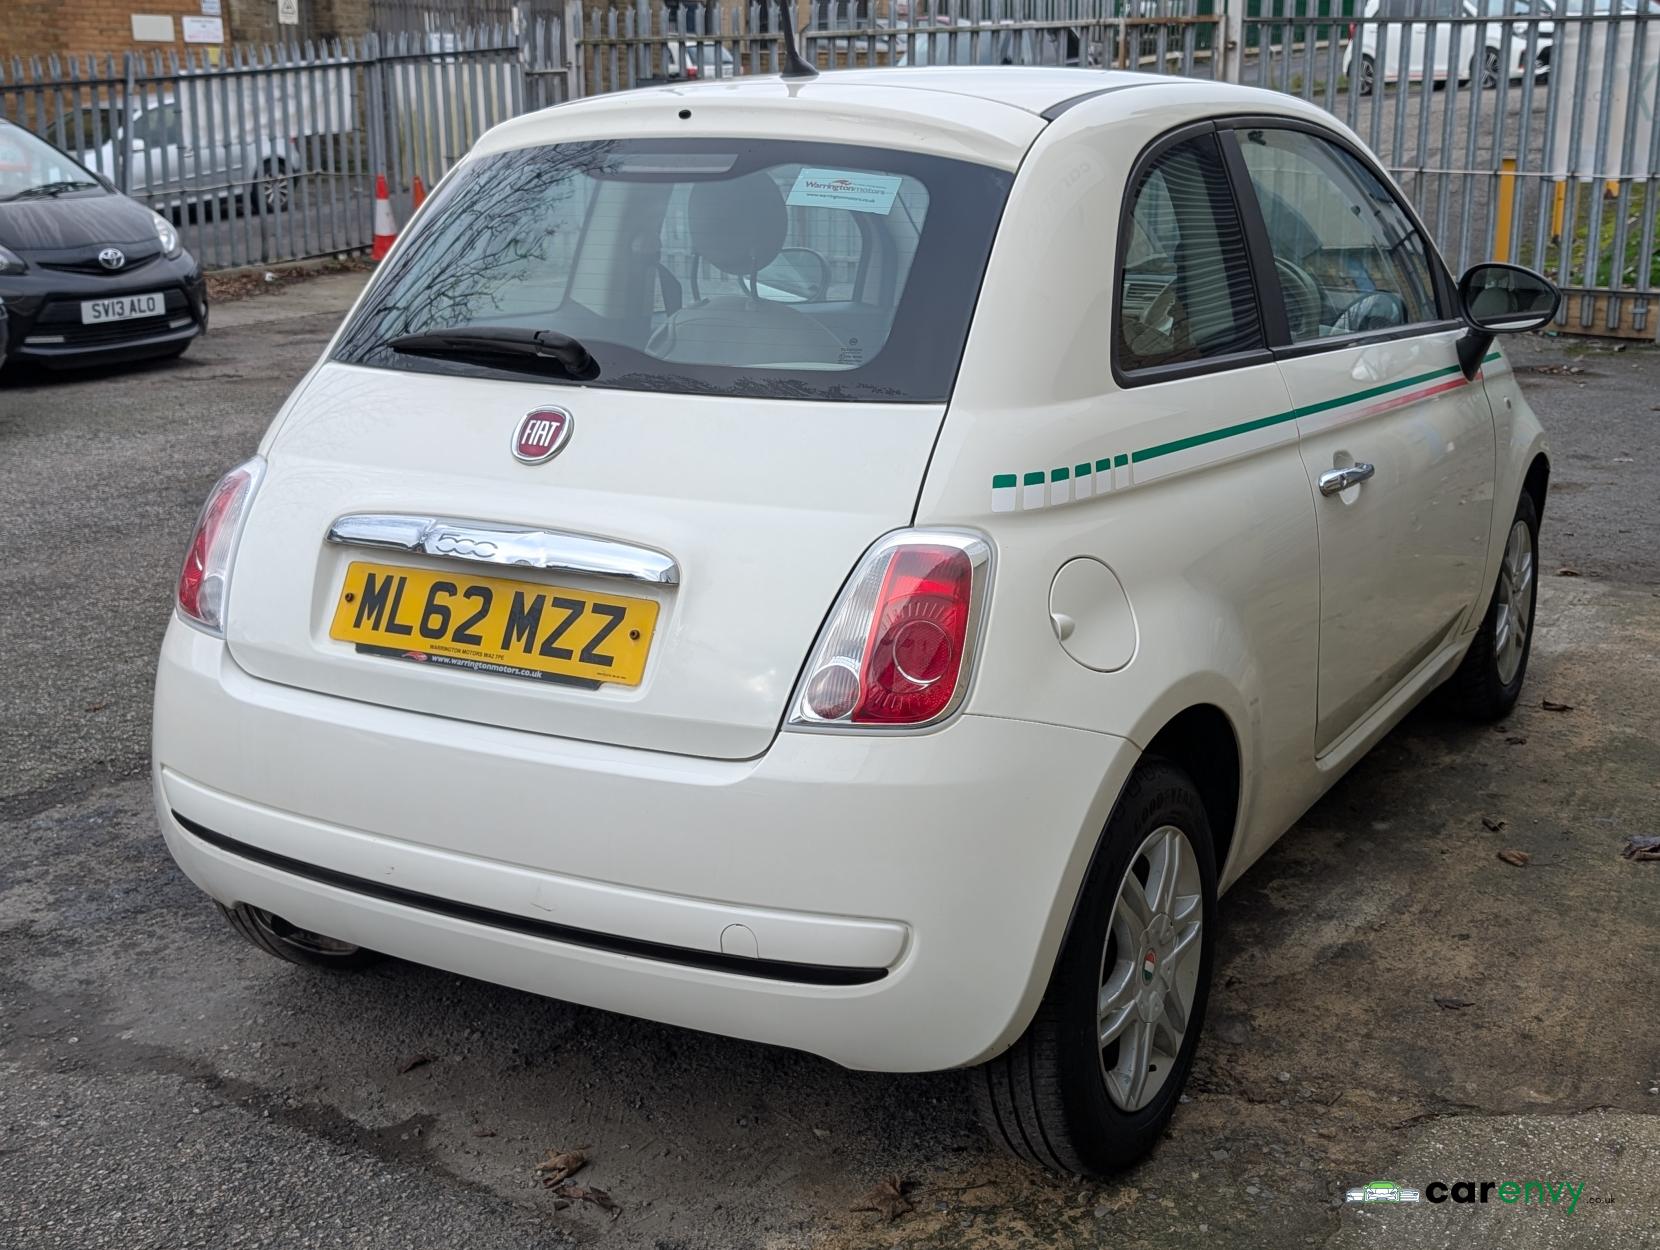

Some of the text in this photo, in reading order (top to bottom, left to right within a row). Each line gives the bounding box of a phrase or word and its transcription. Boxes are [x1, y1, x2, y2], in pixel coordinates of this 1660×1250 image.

[91, 296, 156, 319] SV13 ALO
[521, 419, 561, 447] FIAT
[435, 533, 498, 558] 500
[352, 572, 627, 668] ML62 MZZ
[431, 655, 543, 679] www.warringtonmotors.co.uk
